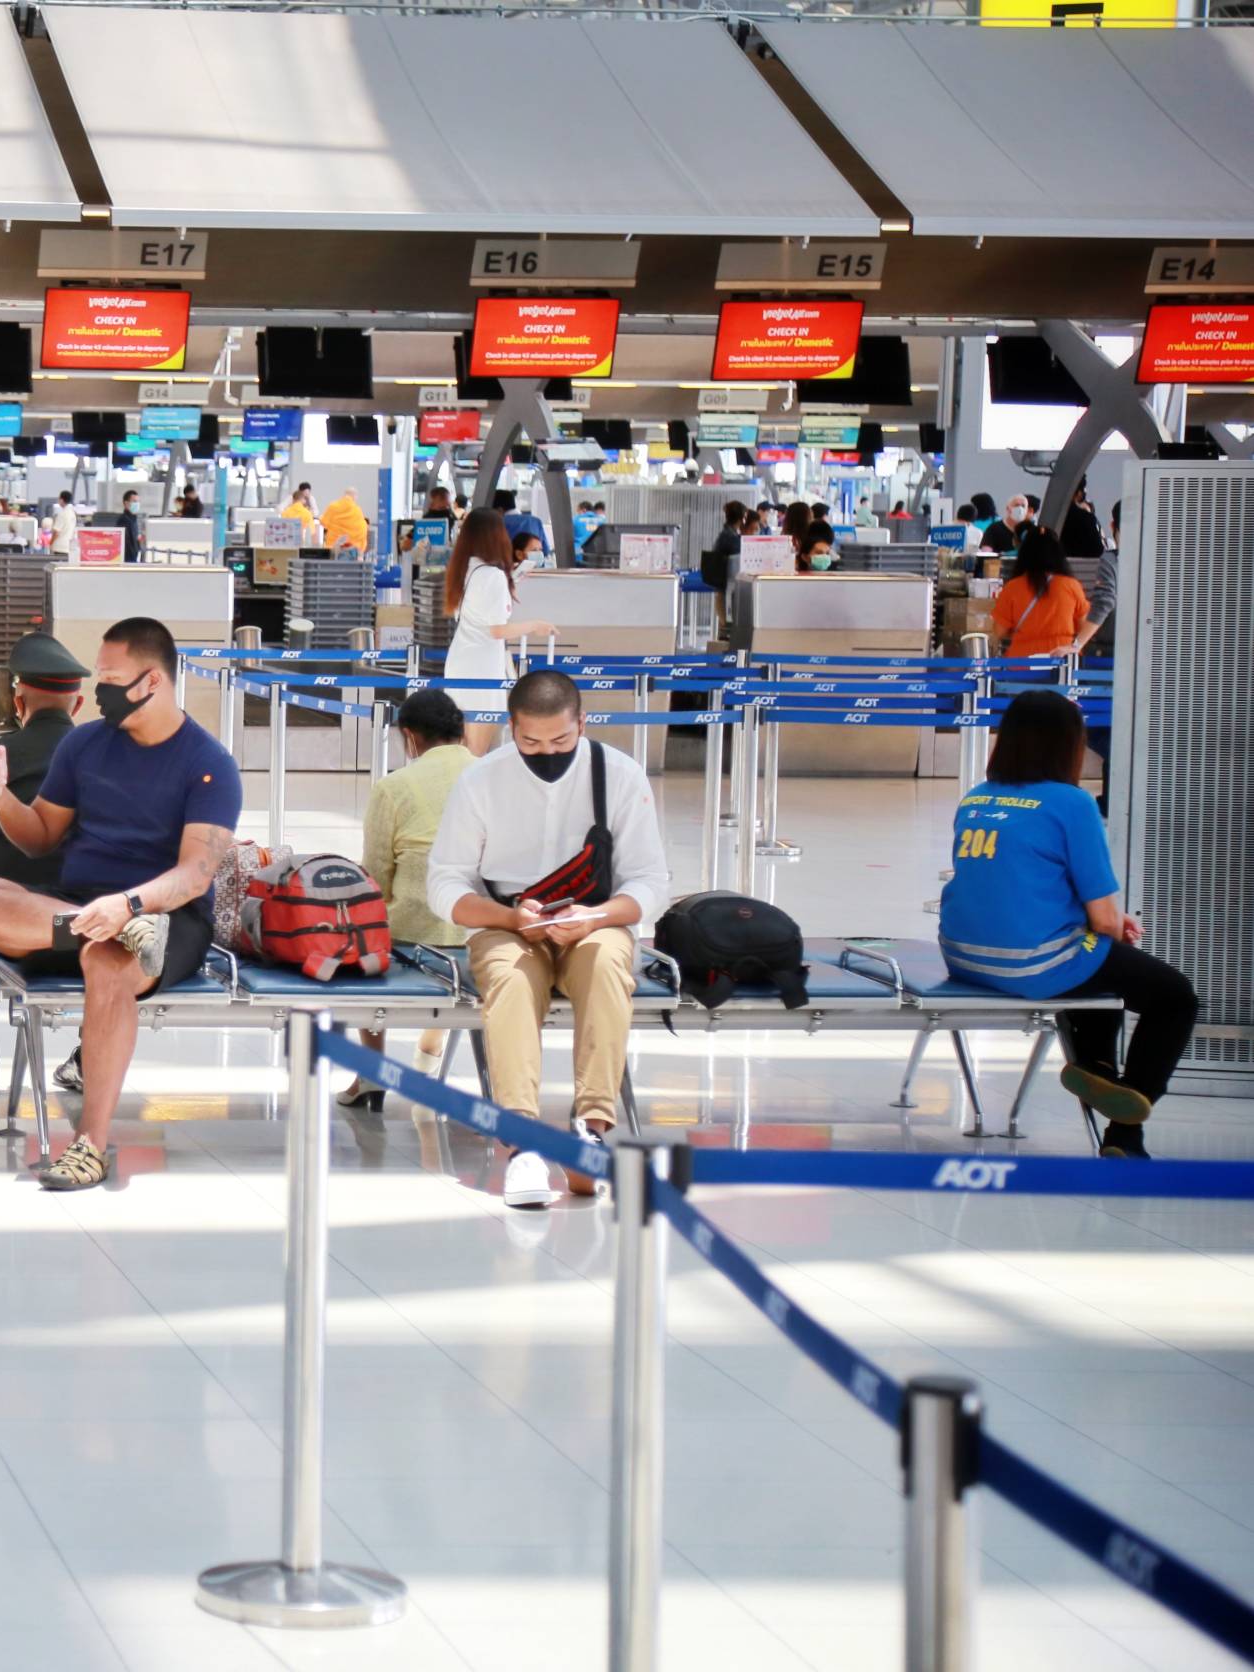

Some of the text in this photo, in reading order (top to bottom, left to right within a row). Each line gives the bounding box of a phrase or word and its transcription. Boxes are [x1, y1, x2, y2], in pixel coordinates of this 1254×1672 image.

[140, 243, 194, 266] E17
[484, 252, 538, 274] E16
[817, 254, 872, 277] E15
[1160, 258, 1216, 281] E14
[95, 316, 137, 325] CHECK IN
[122, 327, 162, 337] Domestic
[524, 324, 565, 333] CHECK IN
[768, 327, 809, 336] CHECK IN
[551, 336, 591, 344] Domestic
[1196, 331, 1237, 340] CHECK IN
[794, 338, 833, 347] Domestic
[144, 388, 168, 398] G14
[562, 656, 582, 664] AOT
[723, 655, 736, 663] AO
[809, 656, 828, 664] AOT
[582, 666, 604, 675] AOT
[670, 668, 692, 676] AOT
[314, 677, 337, 685] AOT
[407, 679, 430, 687] AOT
[814, 684, 837, 692] AOT
[1068, 687, 1091, 695] AOT
[752, 696, 777, 704] AOT
[854, 698, 879, 707] AOT
[475, 713, 501, 722] AOT
[585, 714, 611, 723] AOT
[695, 714, 722, 722] AOT
[844, 714, 870, 723] AOT
[954, 716, 978, 725] AOT
[994, 796, 1042, 808] TROLLEY
[958, 828, 998, 859] 204
[932, 1159, 1018, 1190] AOT
